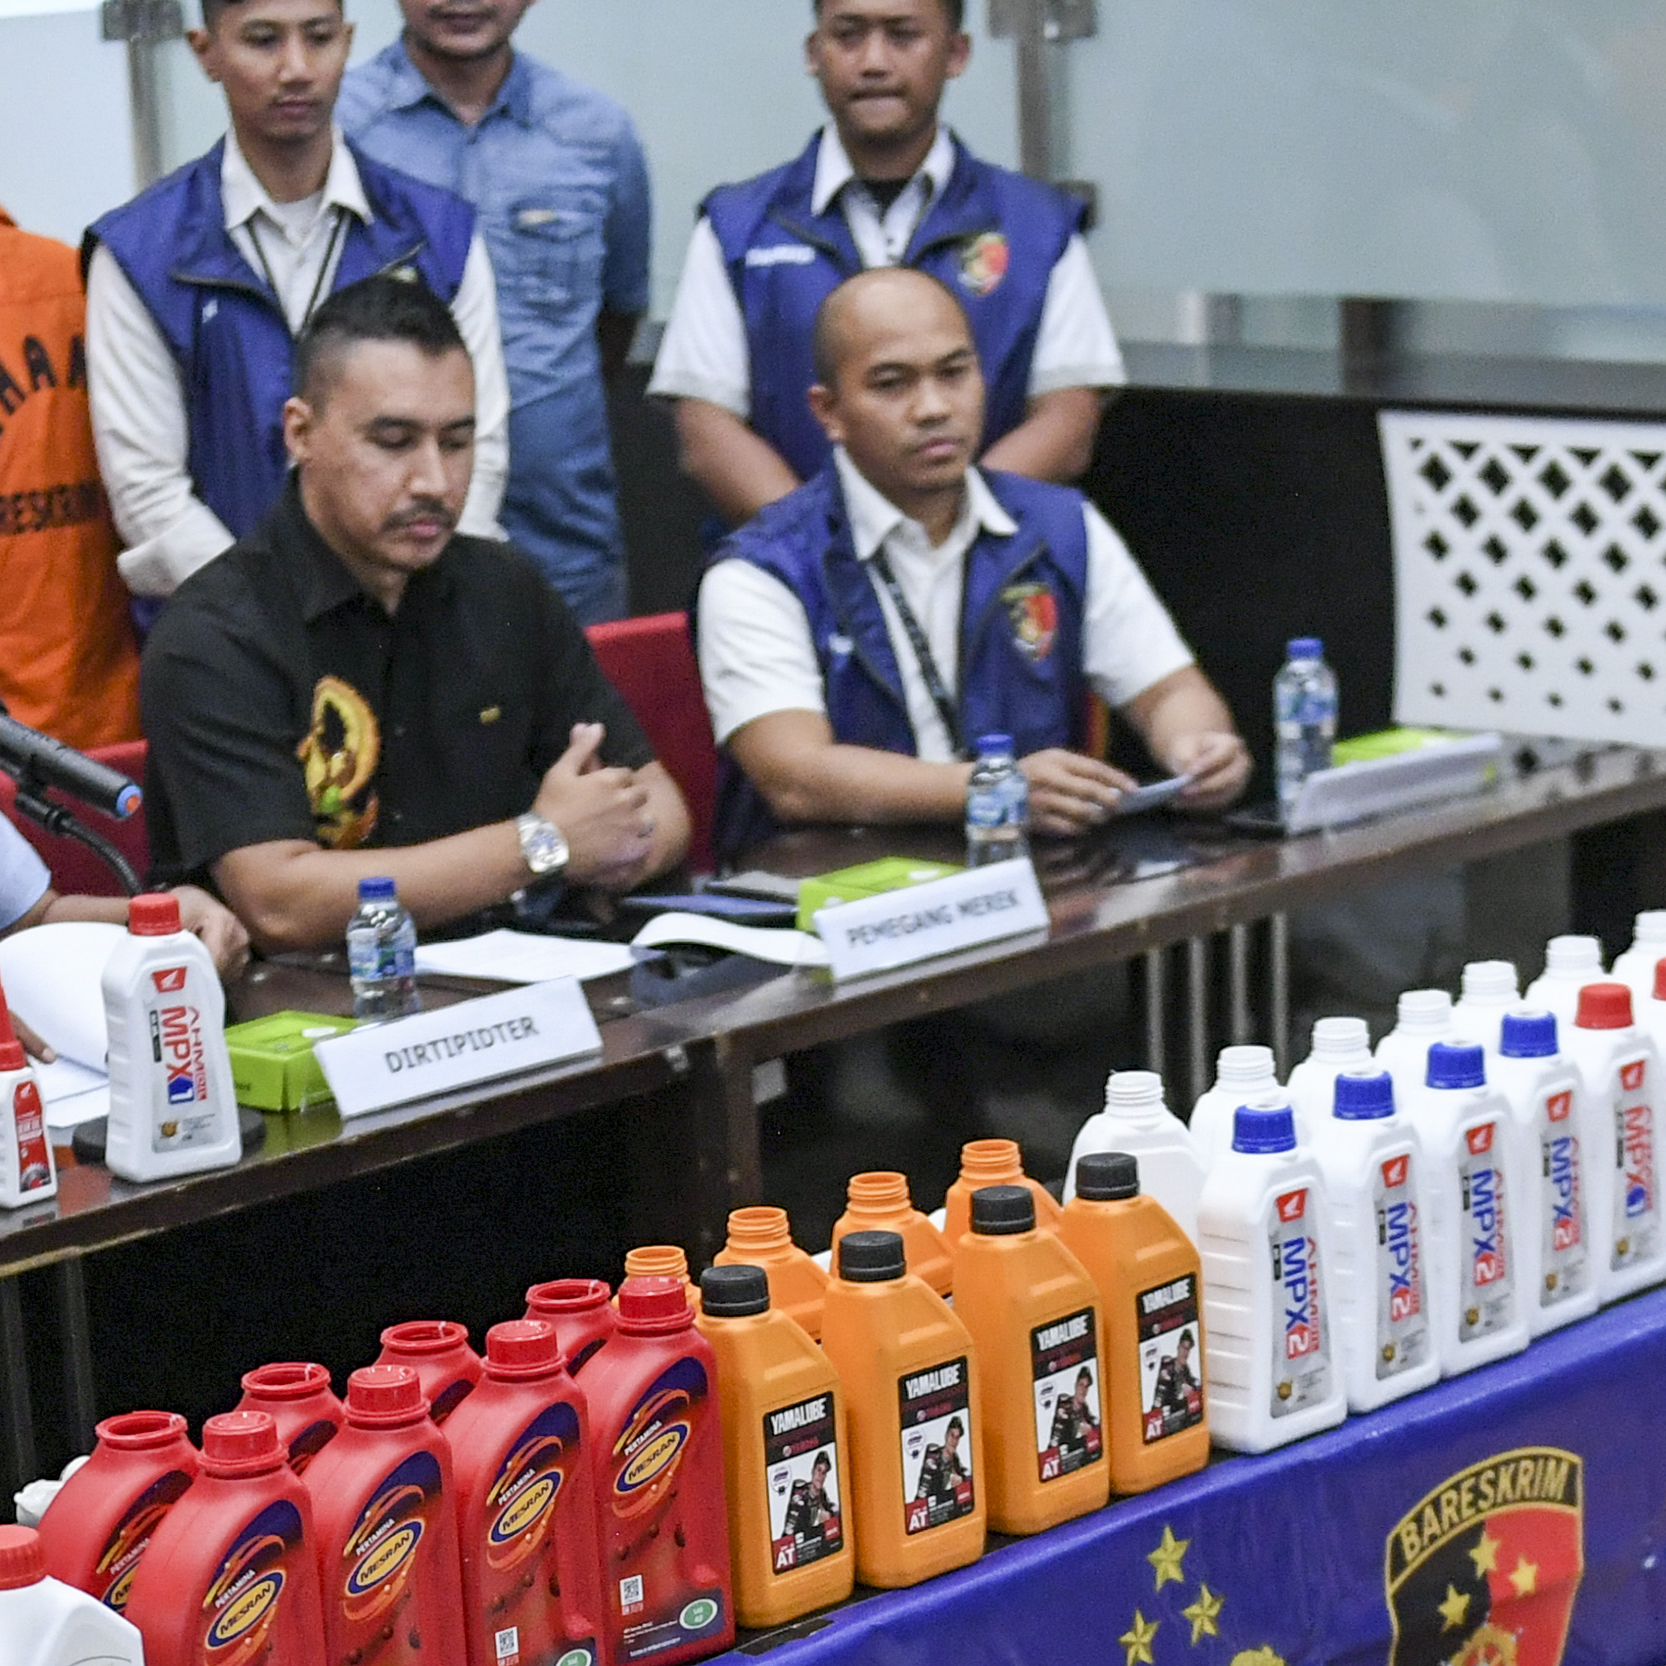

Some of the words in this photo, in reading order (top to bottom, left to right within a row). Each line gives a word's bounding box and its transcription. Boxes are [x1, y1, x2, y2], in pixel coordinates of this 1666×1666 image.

[845, 910, 953, 950] PEMEGANG
[955, 890, 1020, 928] MEREK
[160, 1006, 195, 1105] MPX1
[384, 1014, 540, 1076] DIRTIPIDTER
[1550, 1137, 1573, 1251] MPX2
[1472, 1169, 1495, 1286] MPX2
[1386, 1202, 1412, 1322] MPX2
[1143, 1277, 1191, 1313] YAMALUBE
[1282, 1236, 1310, 1360] MPX2
[1037, 1314, 1090, 1351] YAMALUBE
[906, 1364, 961, 1400] YAMALUBE
[625, 1421, 662, 1456] PERTAMINA
[770, 1399, 827, 1436] YAMALUBE
[1145, 1421, 1163, 1440] AT
[628, 1434, 676, 1483] MESRAN
[1042, 1460, 1060, 1480] AT
[498, 1468, 536, 1505] PERTAMINA
[502, 1482, 549, 1533] MESRAN
[909, 1511, 928, 1531] AT
[1399, 1459, 1569, 1562] BARESKRIM
[355, 1517, 396, 1556] PERTAMINA
[360, 1533, 412, 1584] MESRAN
[775, 1548, 795, 1570] AT
[214, 1569, 256, 1608] PERTAMINA
[219, 1583, 271, 1636] MESRAN
